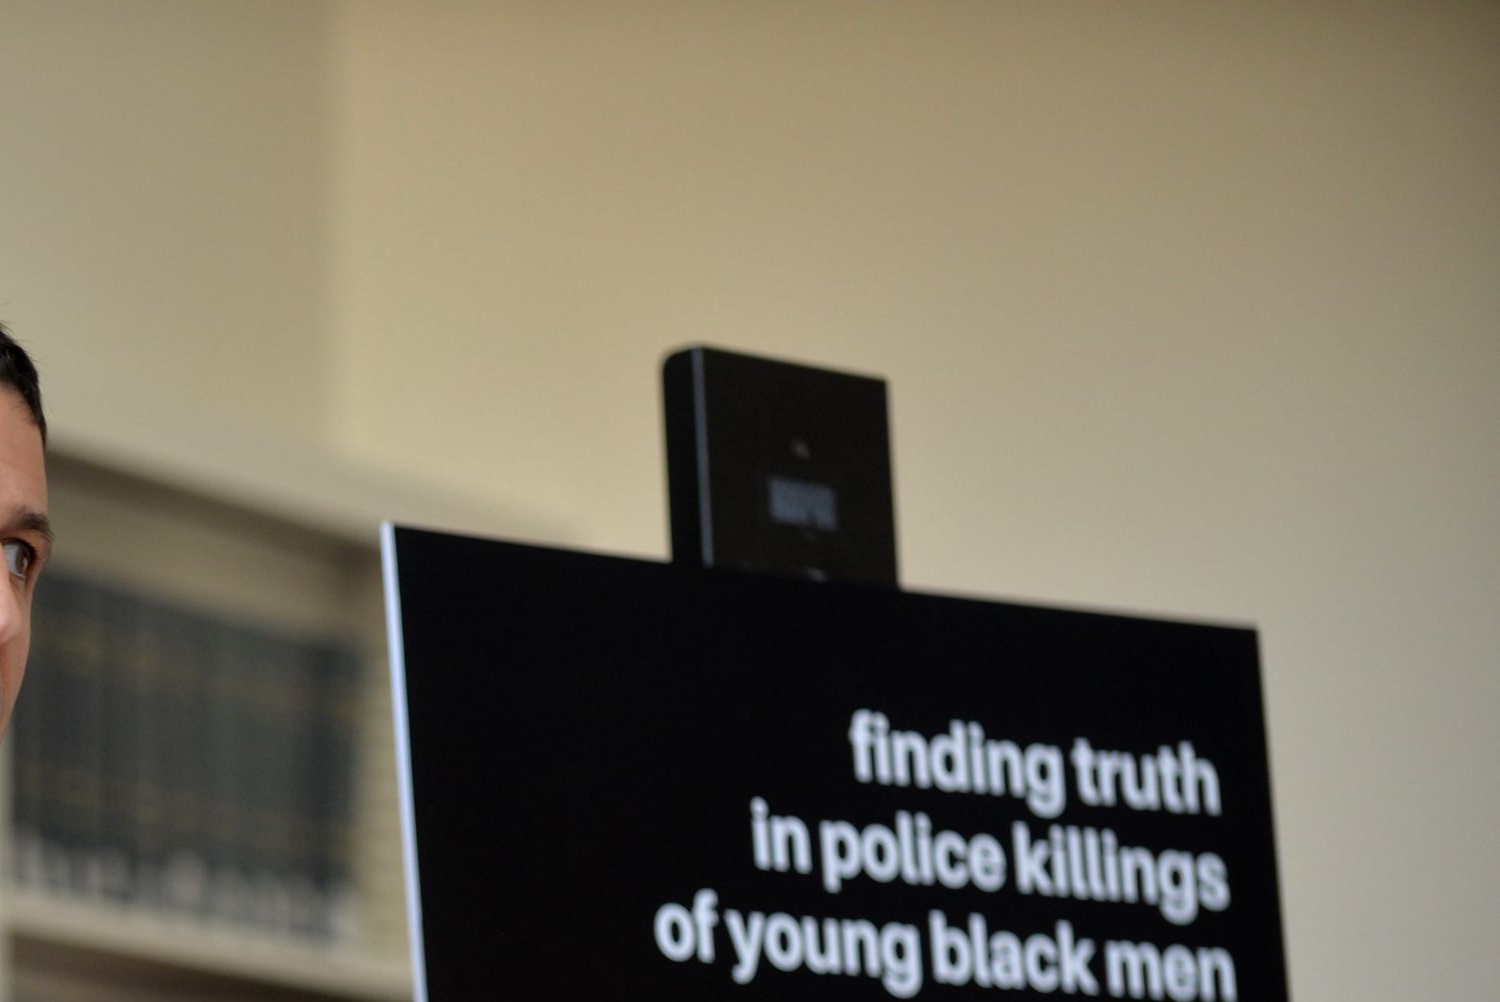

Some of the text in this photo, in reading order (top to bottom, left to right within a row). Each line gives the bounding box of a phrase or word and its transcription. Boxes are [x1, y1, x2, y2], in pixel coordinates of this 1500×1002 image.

[849, 708, 1222, 819] finding truth
[750, 797, 1231, 925] in police killings
[654, 888, 719, 963] of
[725, 908, 924, 999] young
[928, 909, 1100, 995] black
